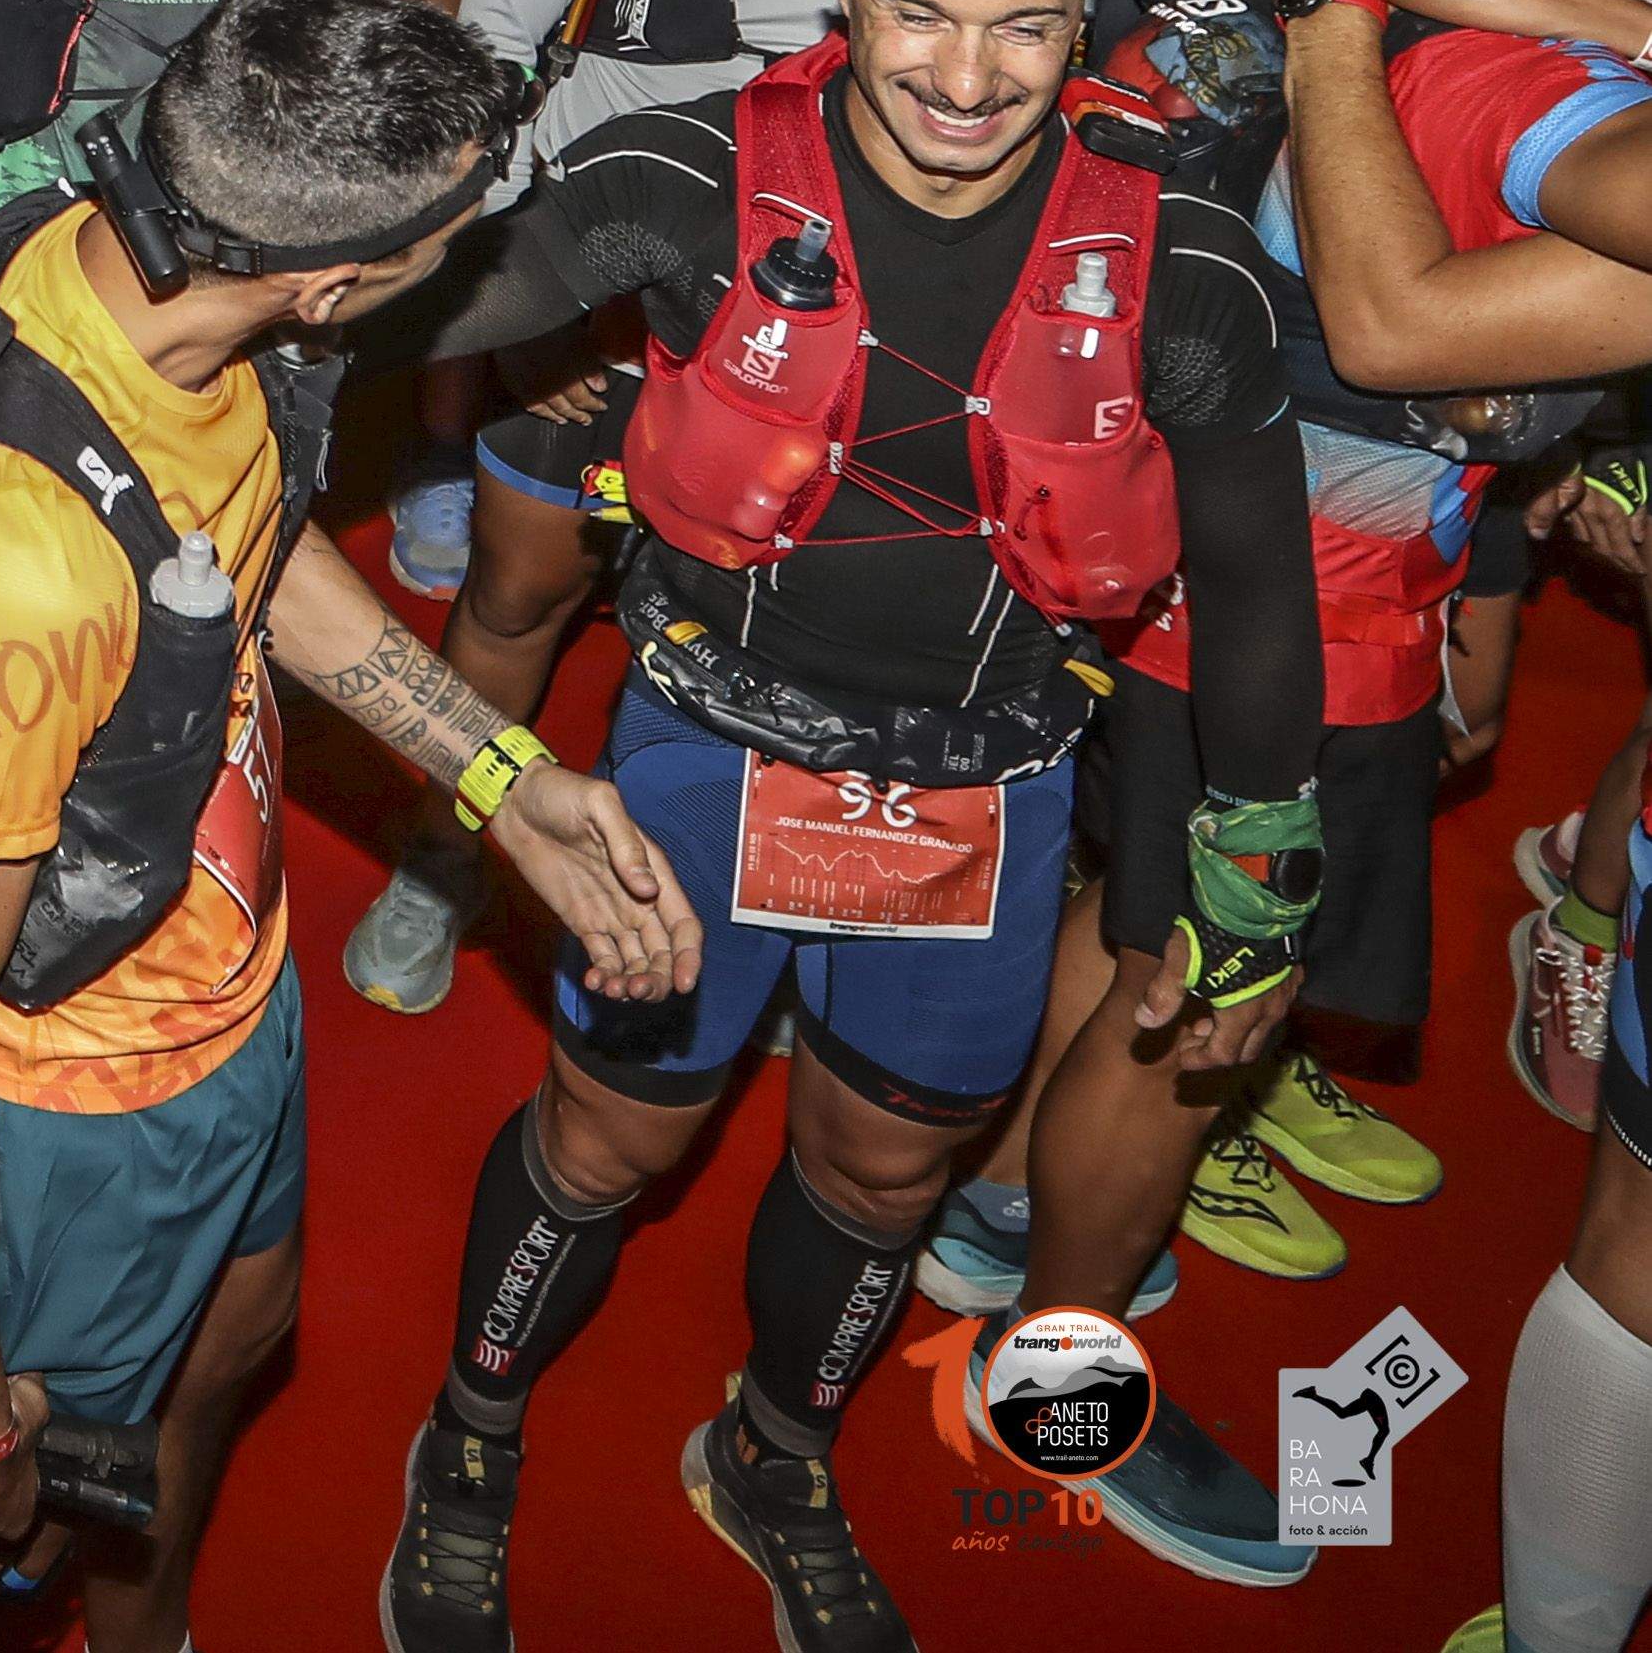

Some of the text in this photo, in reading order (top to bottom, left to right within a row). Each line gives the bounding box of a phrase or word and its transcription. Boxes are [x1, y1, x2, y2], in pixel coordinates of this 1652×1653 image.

[776, 817, 974, 854] JOSE MANUEL FERNANDEZ GRANADO
[1206, 946, 1255, 990] LEKI
